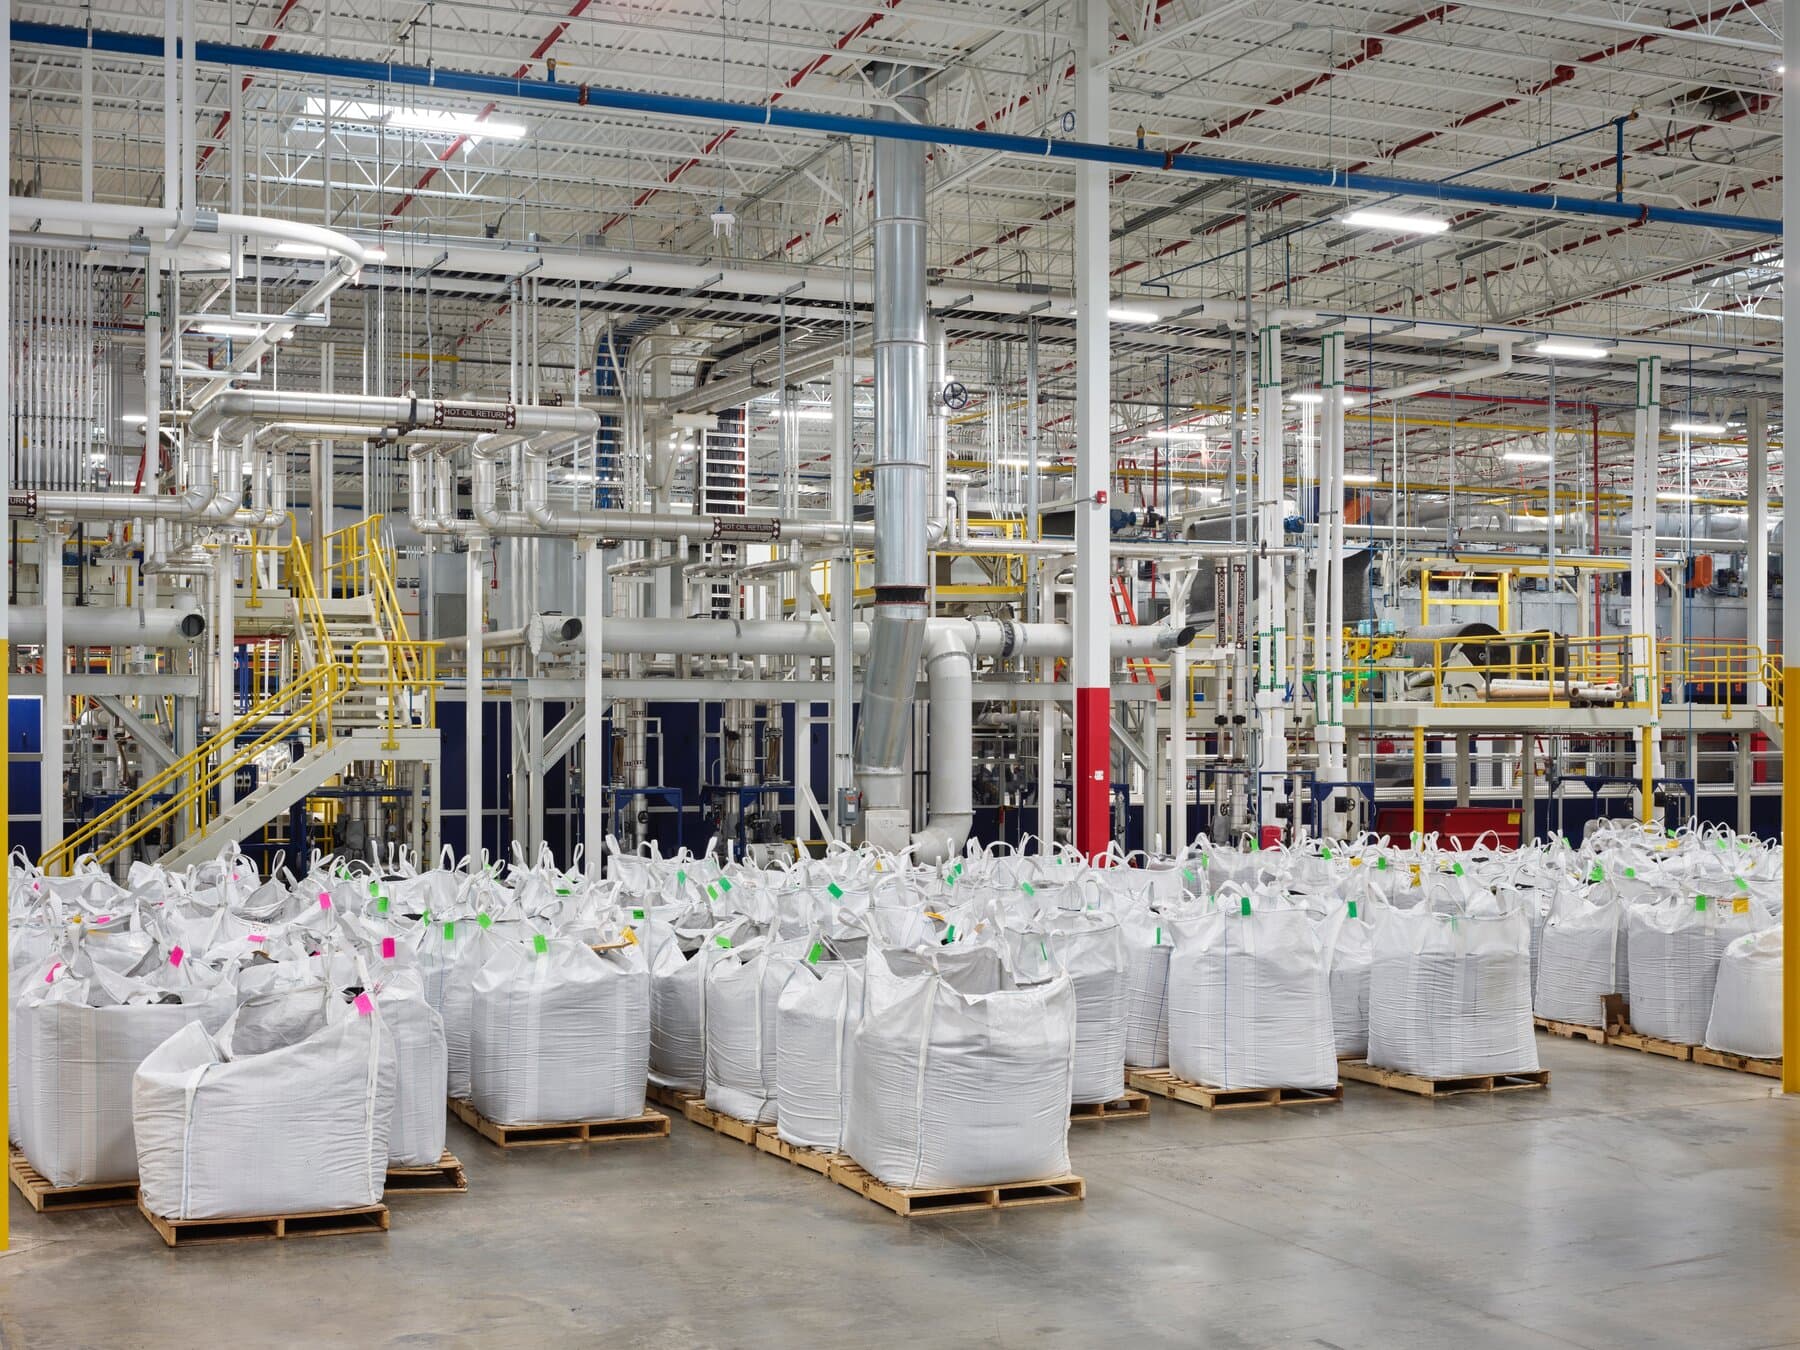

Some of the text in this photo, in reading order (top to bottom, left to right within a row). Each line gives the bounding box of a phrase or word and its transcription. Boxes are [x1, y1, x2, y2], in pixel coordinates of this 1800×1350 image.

[444, 408, 507, 419] HOT OIL RETURN
